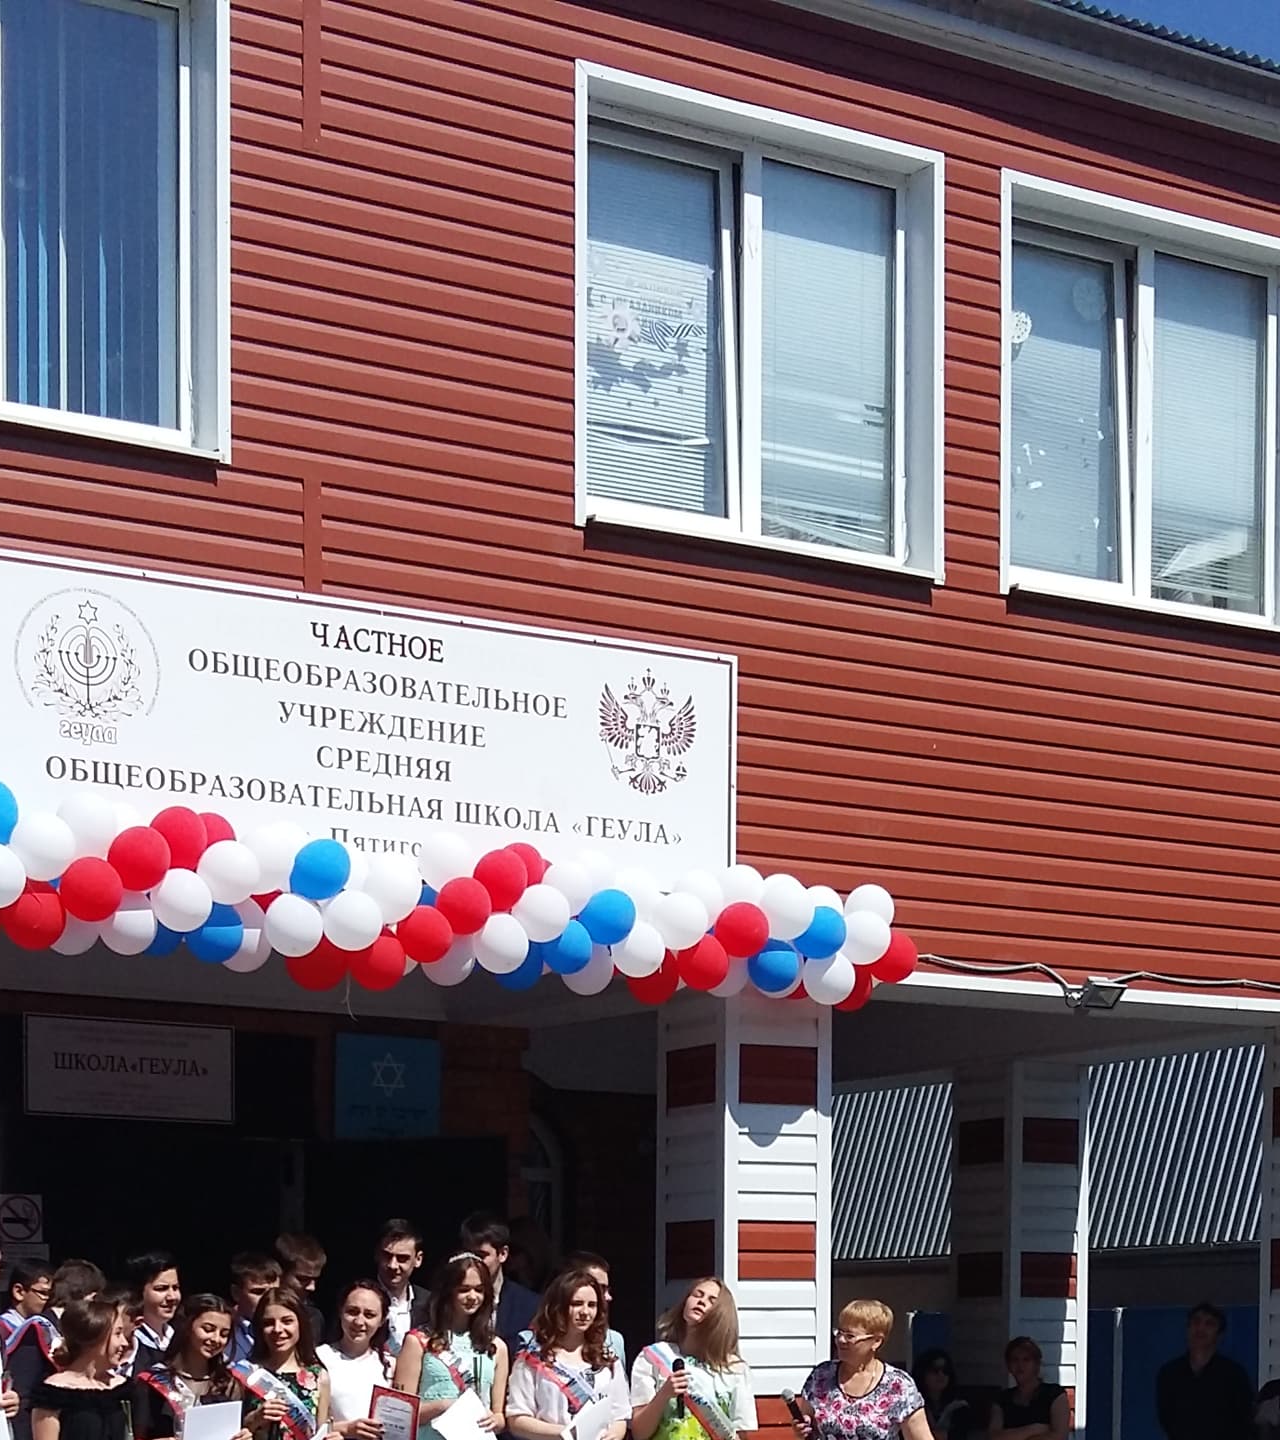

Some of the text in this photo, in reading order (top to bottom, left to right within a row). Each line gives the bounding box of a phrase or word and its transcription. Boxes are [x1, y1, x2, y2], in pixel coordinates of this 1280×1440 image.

[310, 621, 444, 663] ЧАСТНОЕ
[188, 648, 568, 719] ОБЩЕОБРАЗОВАТЕЛЬНОЕ
[278, 700, 486, 748] УЧРЕЖДЕНИЕ
[316, 745, 452, 782] СРЕДНЯЯ
[45, 755, 682, 844] ОБЩЕОБРАЗОВАТЕЛЬНАЯ ШКОЛА «ГЕУЛА»
[330, 827, 422, 857] Пятиго
